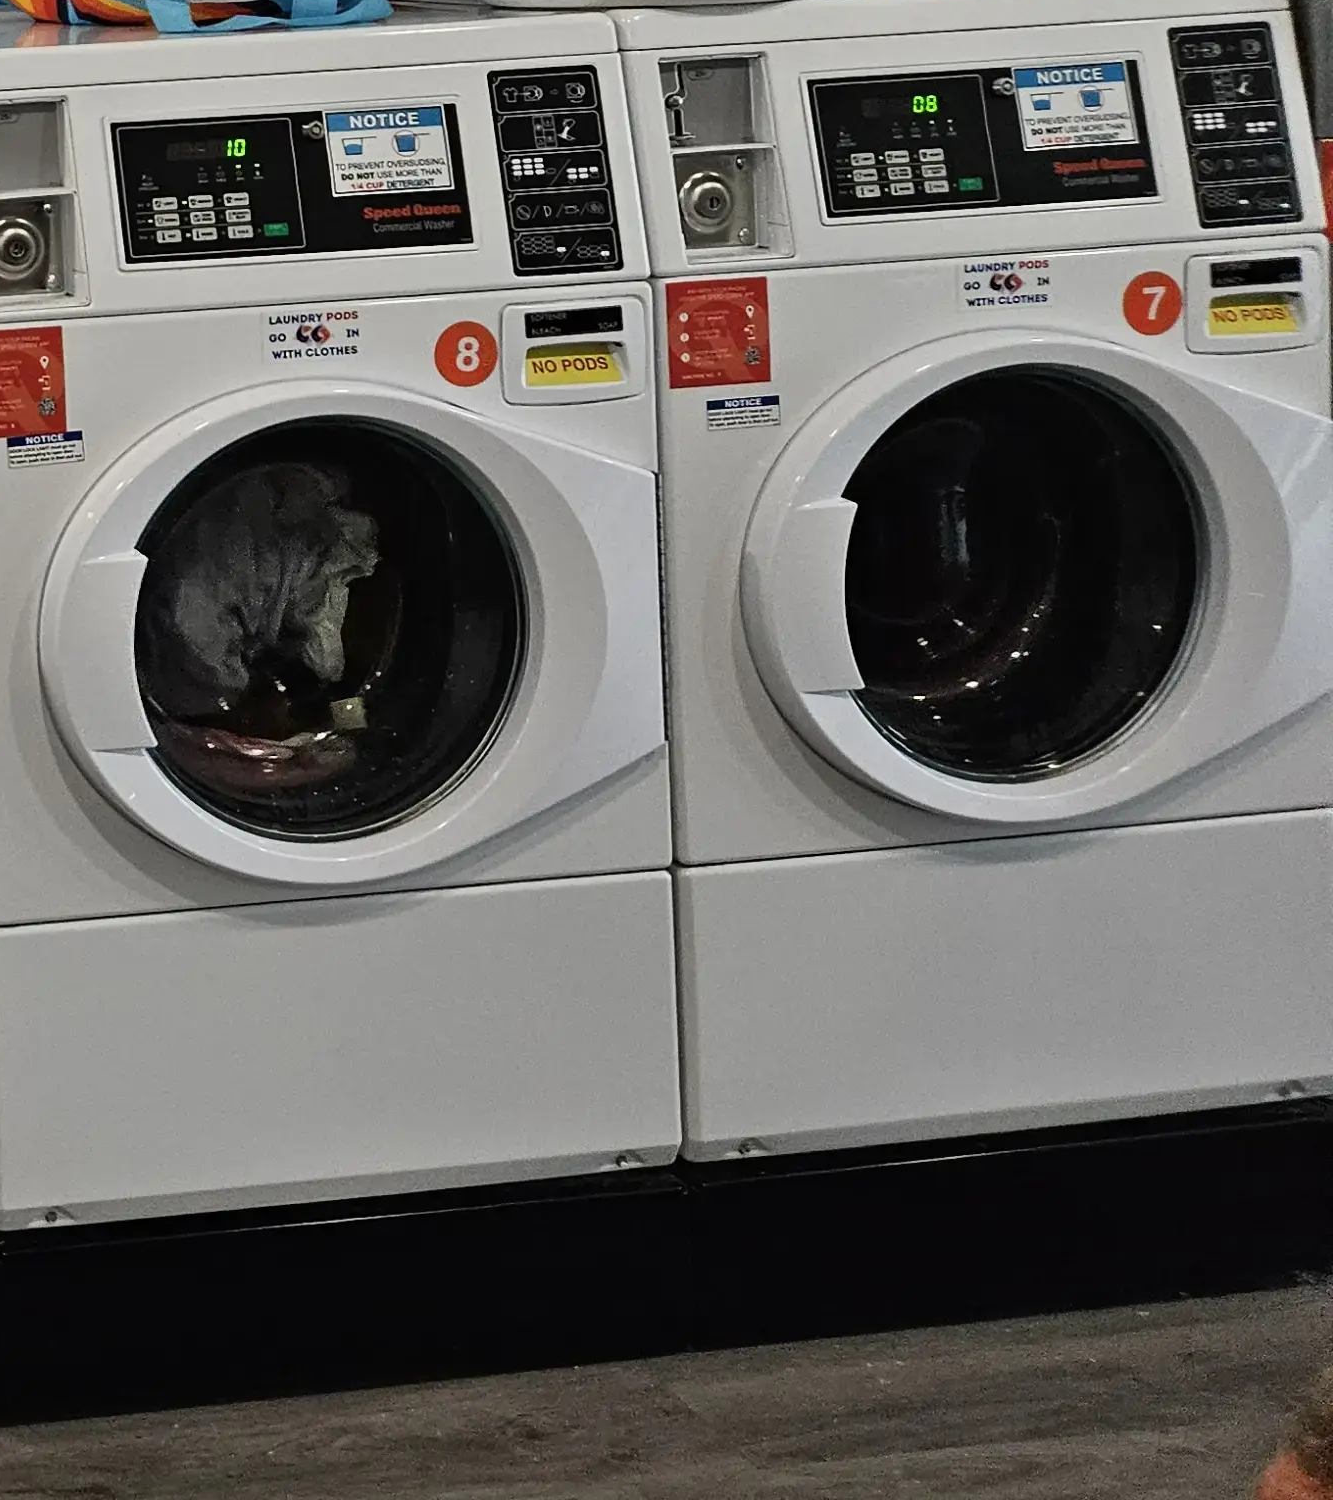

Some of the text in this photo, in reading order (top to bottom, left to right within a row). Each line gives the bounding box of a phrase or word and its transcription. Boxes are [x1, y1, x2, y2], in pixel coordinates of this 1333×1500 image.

[1037, 68, 1103, 84] NOTICE
[913, 95, 938, 113] 08
[349, 112, 419, 129] NOTICE
[227, 139, 245, 156] 10
[964, 259, 1049, 273] LAUNDRY PODS
[964, 276, 1049, 290] GO IN
[967, 293, 1048, 307] WITH CLOTHES
[1142, 286, 1167, 320] 7
[269, 311, 358, 325] LAUNDRY PODS
[1212, 307, 1284, 323] NO PODS
[269, 328, 359, 342] GO IN
[272, 345, 357, 359] WITH CLOTHES
[456, 336, 479, 372] 8
[533, 356, 608, 374] NO PODS
[725, 398, 762, 408] NOTICE
[25, 434, 64, 444] NOTICE
